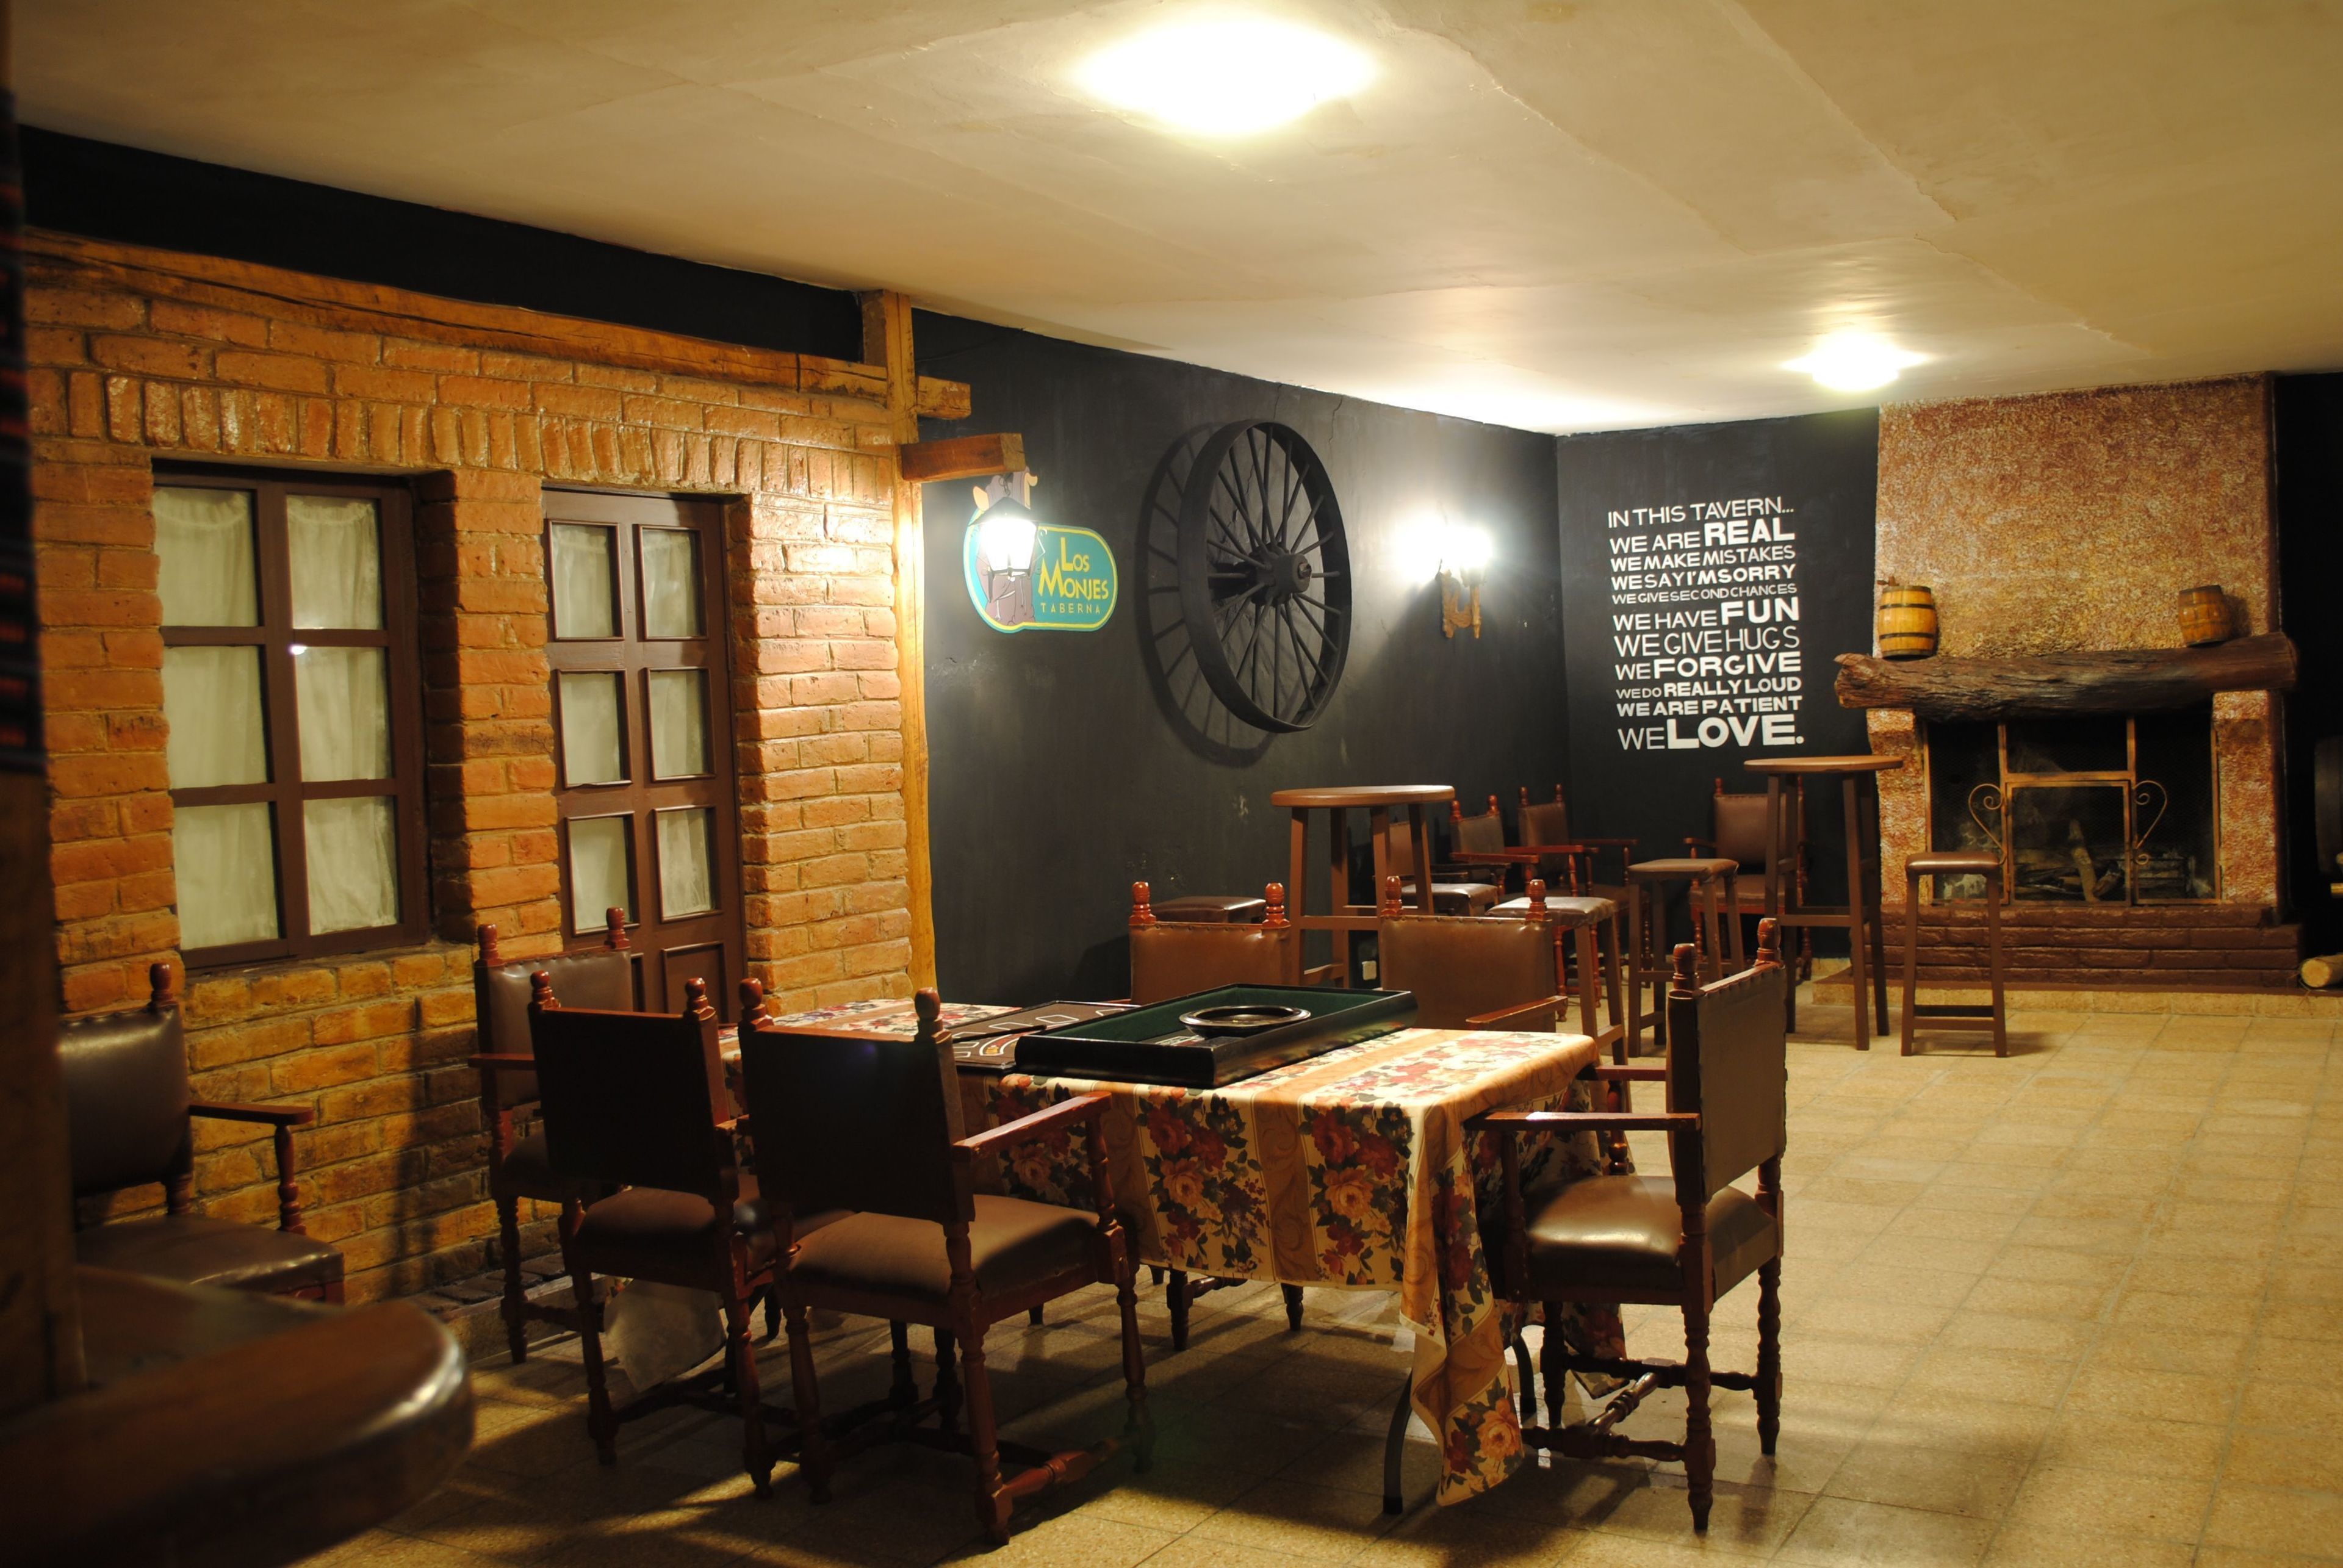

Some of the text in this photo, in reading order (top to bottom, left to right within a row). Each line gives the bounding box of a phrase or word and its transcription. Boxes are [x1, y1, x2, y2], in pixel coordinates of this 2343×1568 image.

[1607, 496, 1794, 529] IN THIS TAVERN...
[1609, 517, 1796, 555] WE ARE REAL
[1061, 538, 1089, 572] LOS
[1610, 544, 1796, 573] WE MAKE MISTAKES
[1038, 559, 1108, 600] MONJES
[1610, 563, 1796, 591] WE SAY I'M SORRY
[1041, 602, 1101, 614] TABERNA
[1611, 583, 1798, 605] WE GIVE SECOND CHANCES
[1612, 596, 1799, 631] WE HAVE FUN
[1613, 625, 1800, 658] WE GIVE HUGS
[1614, 650, 1801, 681] WE FORGIVE
[1616, 676, 1802, 699] WE DO REALLY LOUD
[1616, 695, 1802, 717] WE ARE PATIENT
[1618, 713, 1804, 750] WE LOVE.
